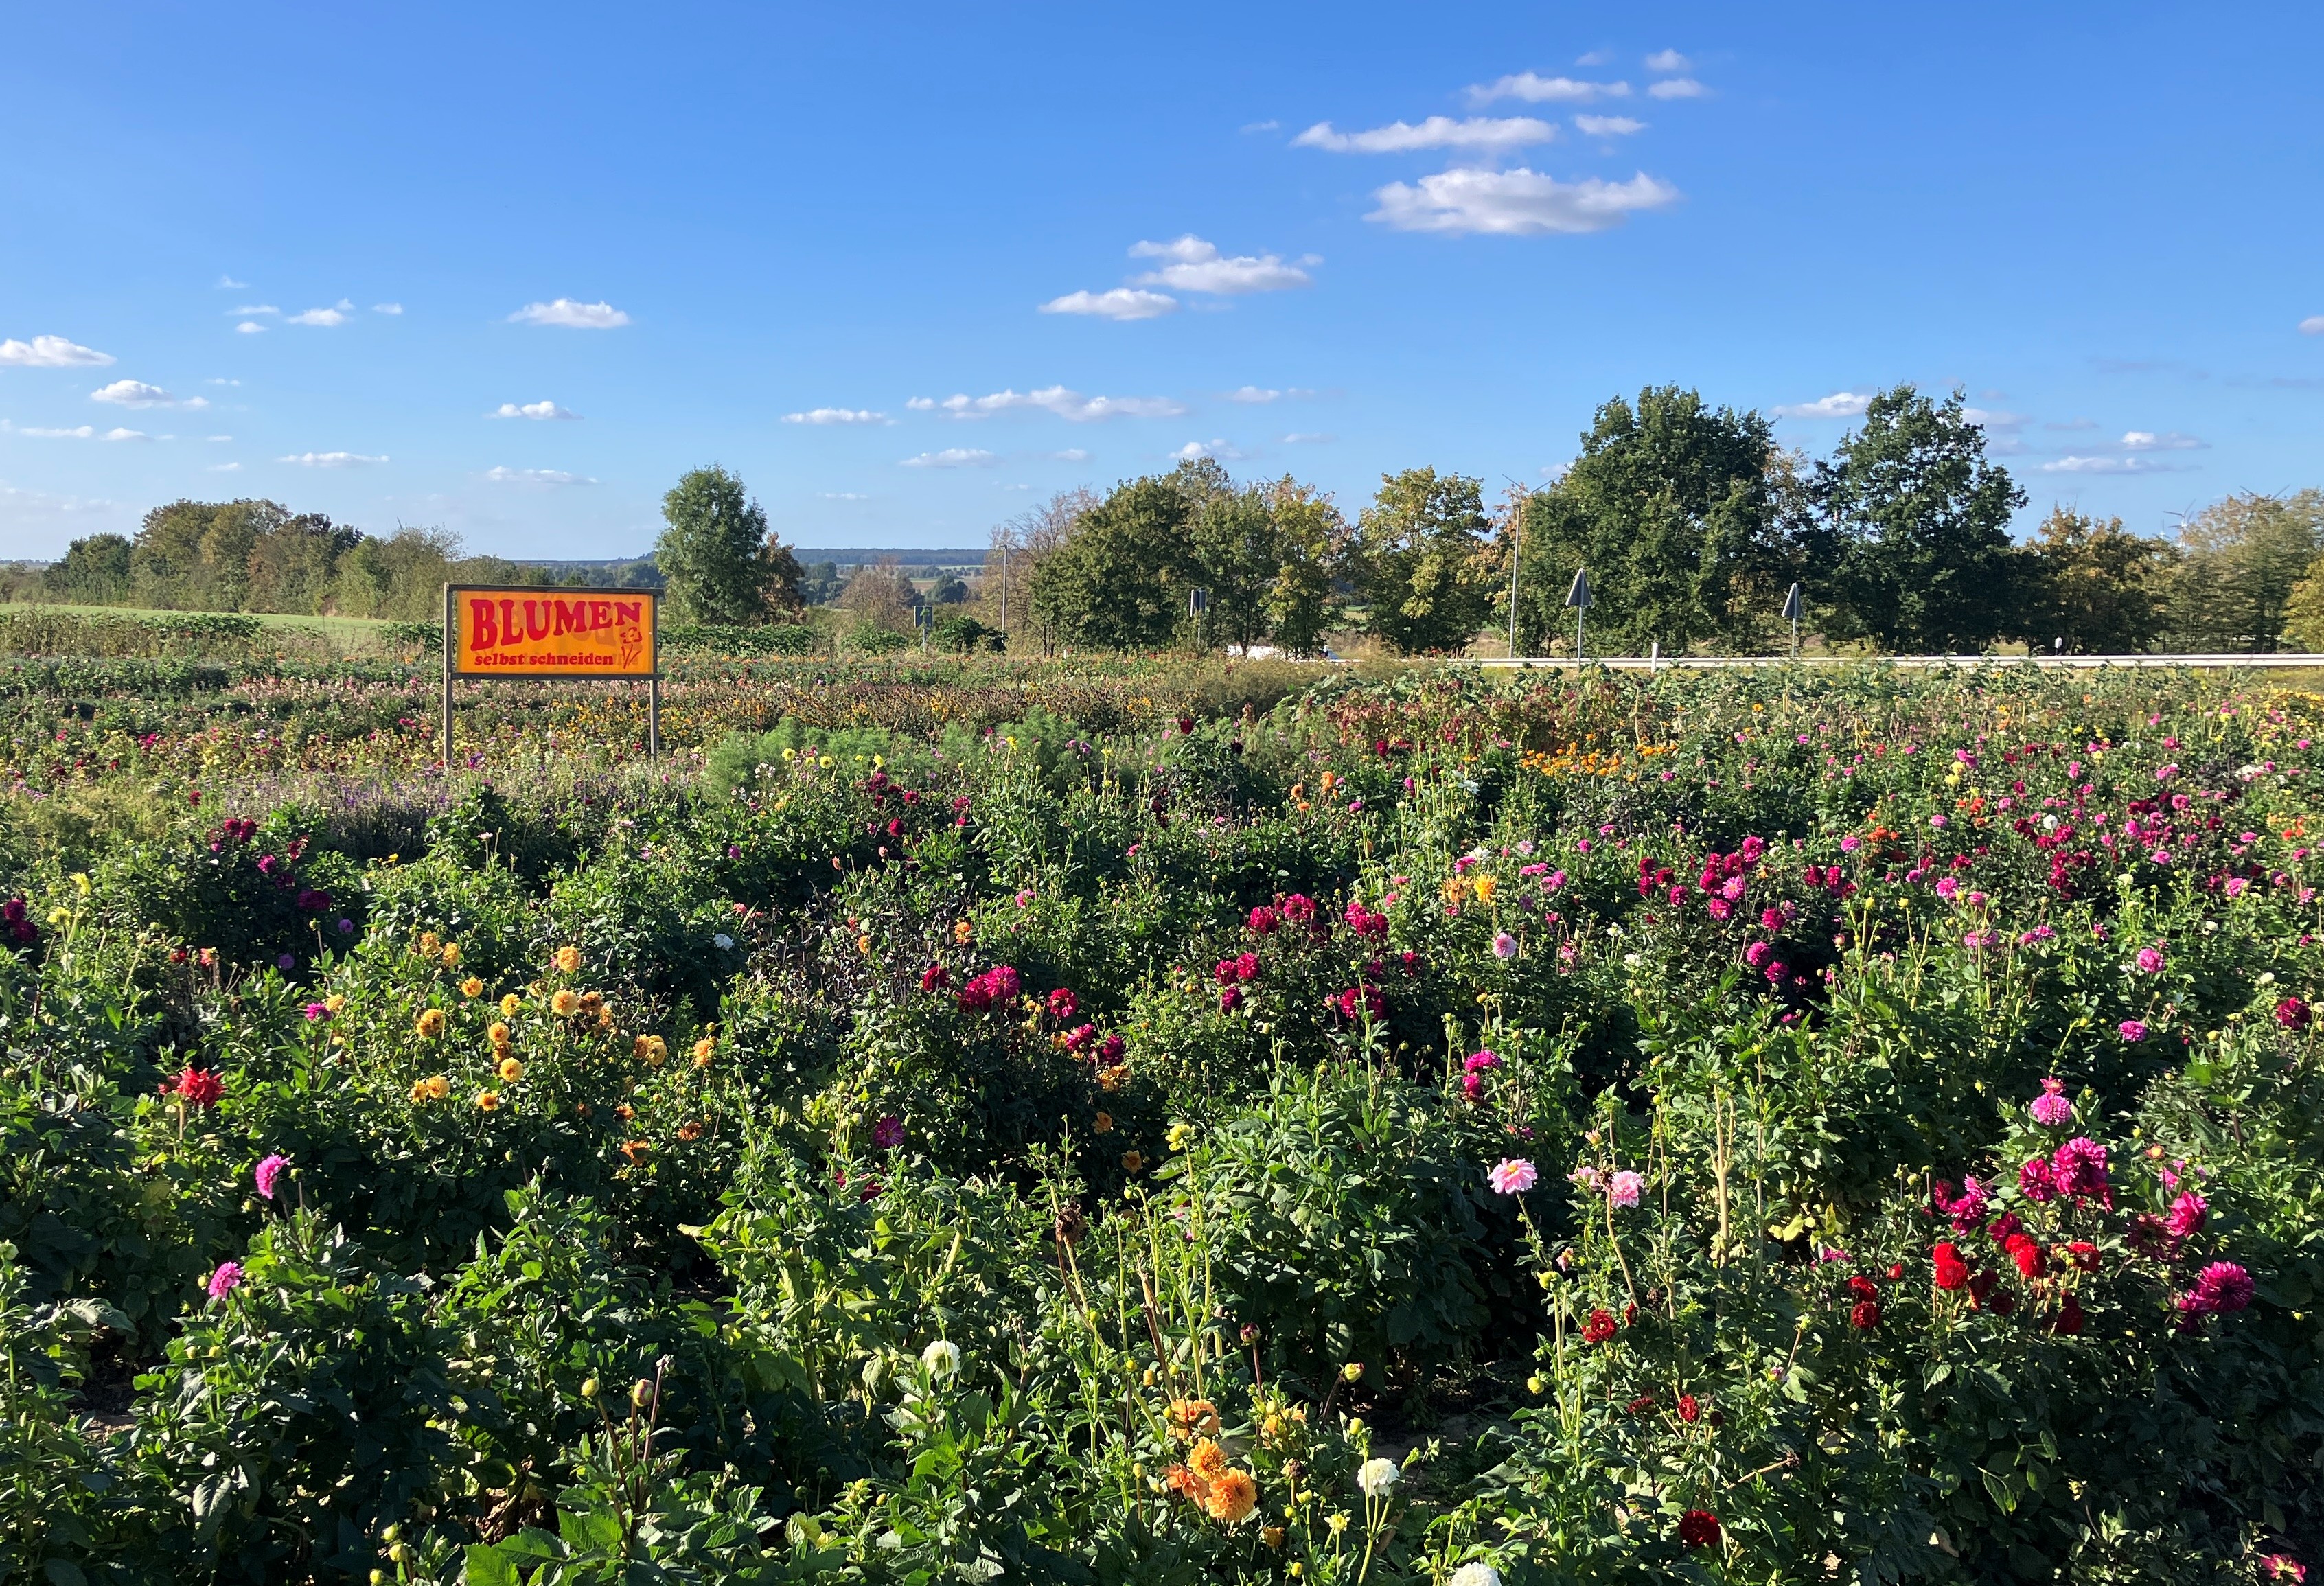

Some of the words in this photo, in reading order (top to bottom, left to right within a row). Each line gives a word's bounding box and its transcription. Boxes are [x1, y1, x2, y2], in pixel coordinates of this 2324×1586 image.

[470, 599, 642, 652] BLUMEN
[474, 653, 525, 666] selbst
[529, 652, 614, 665] schneiden
